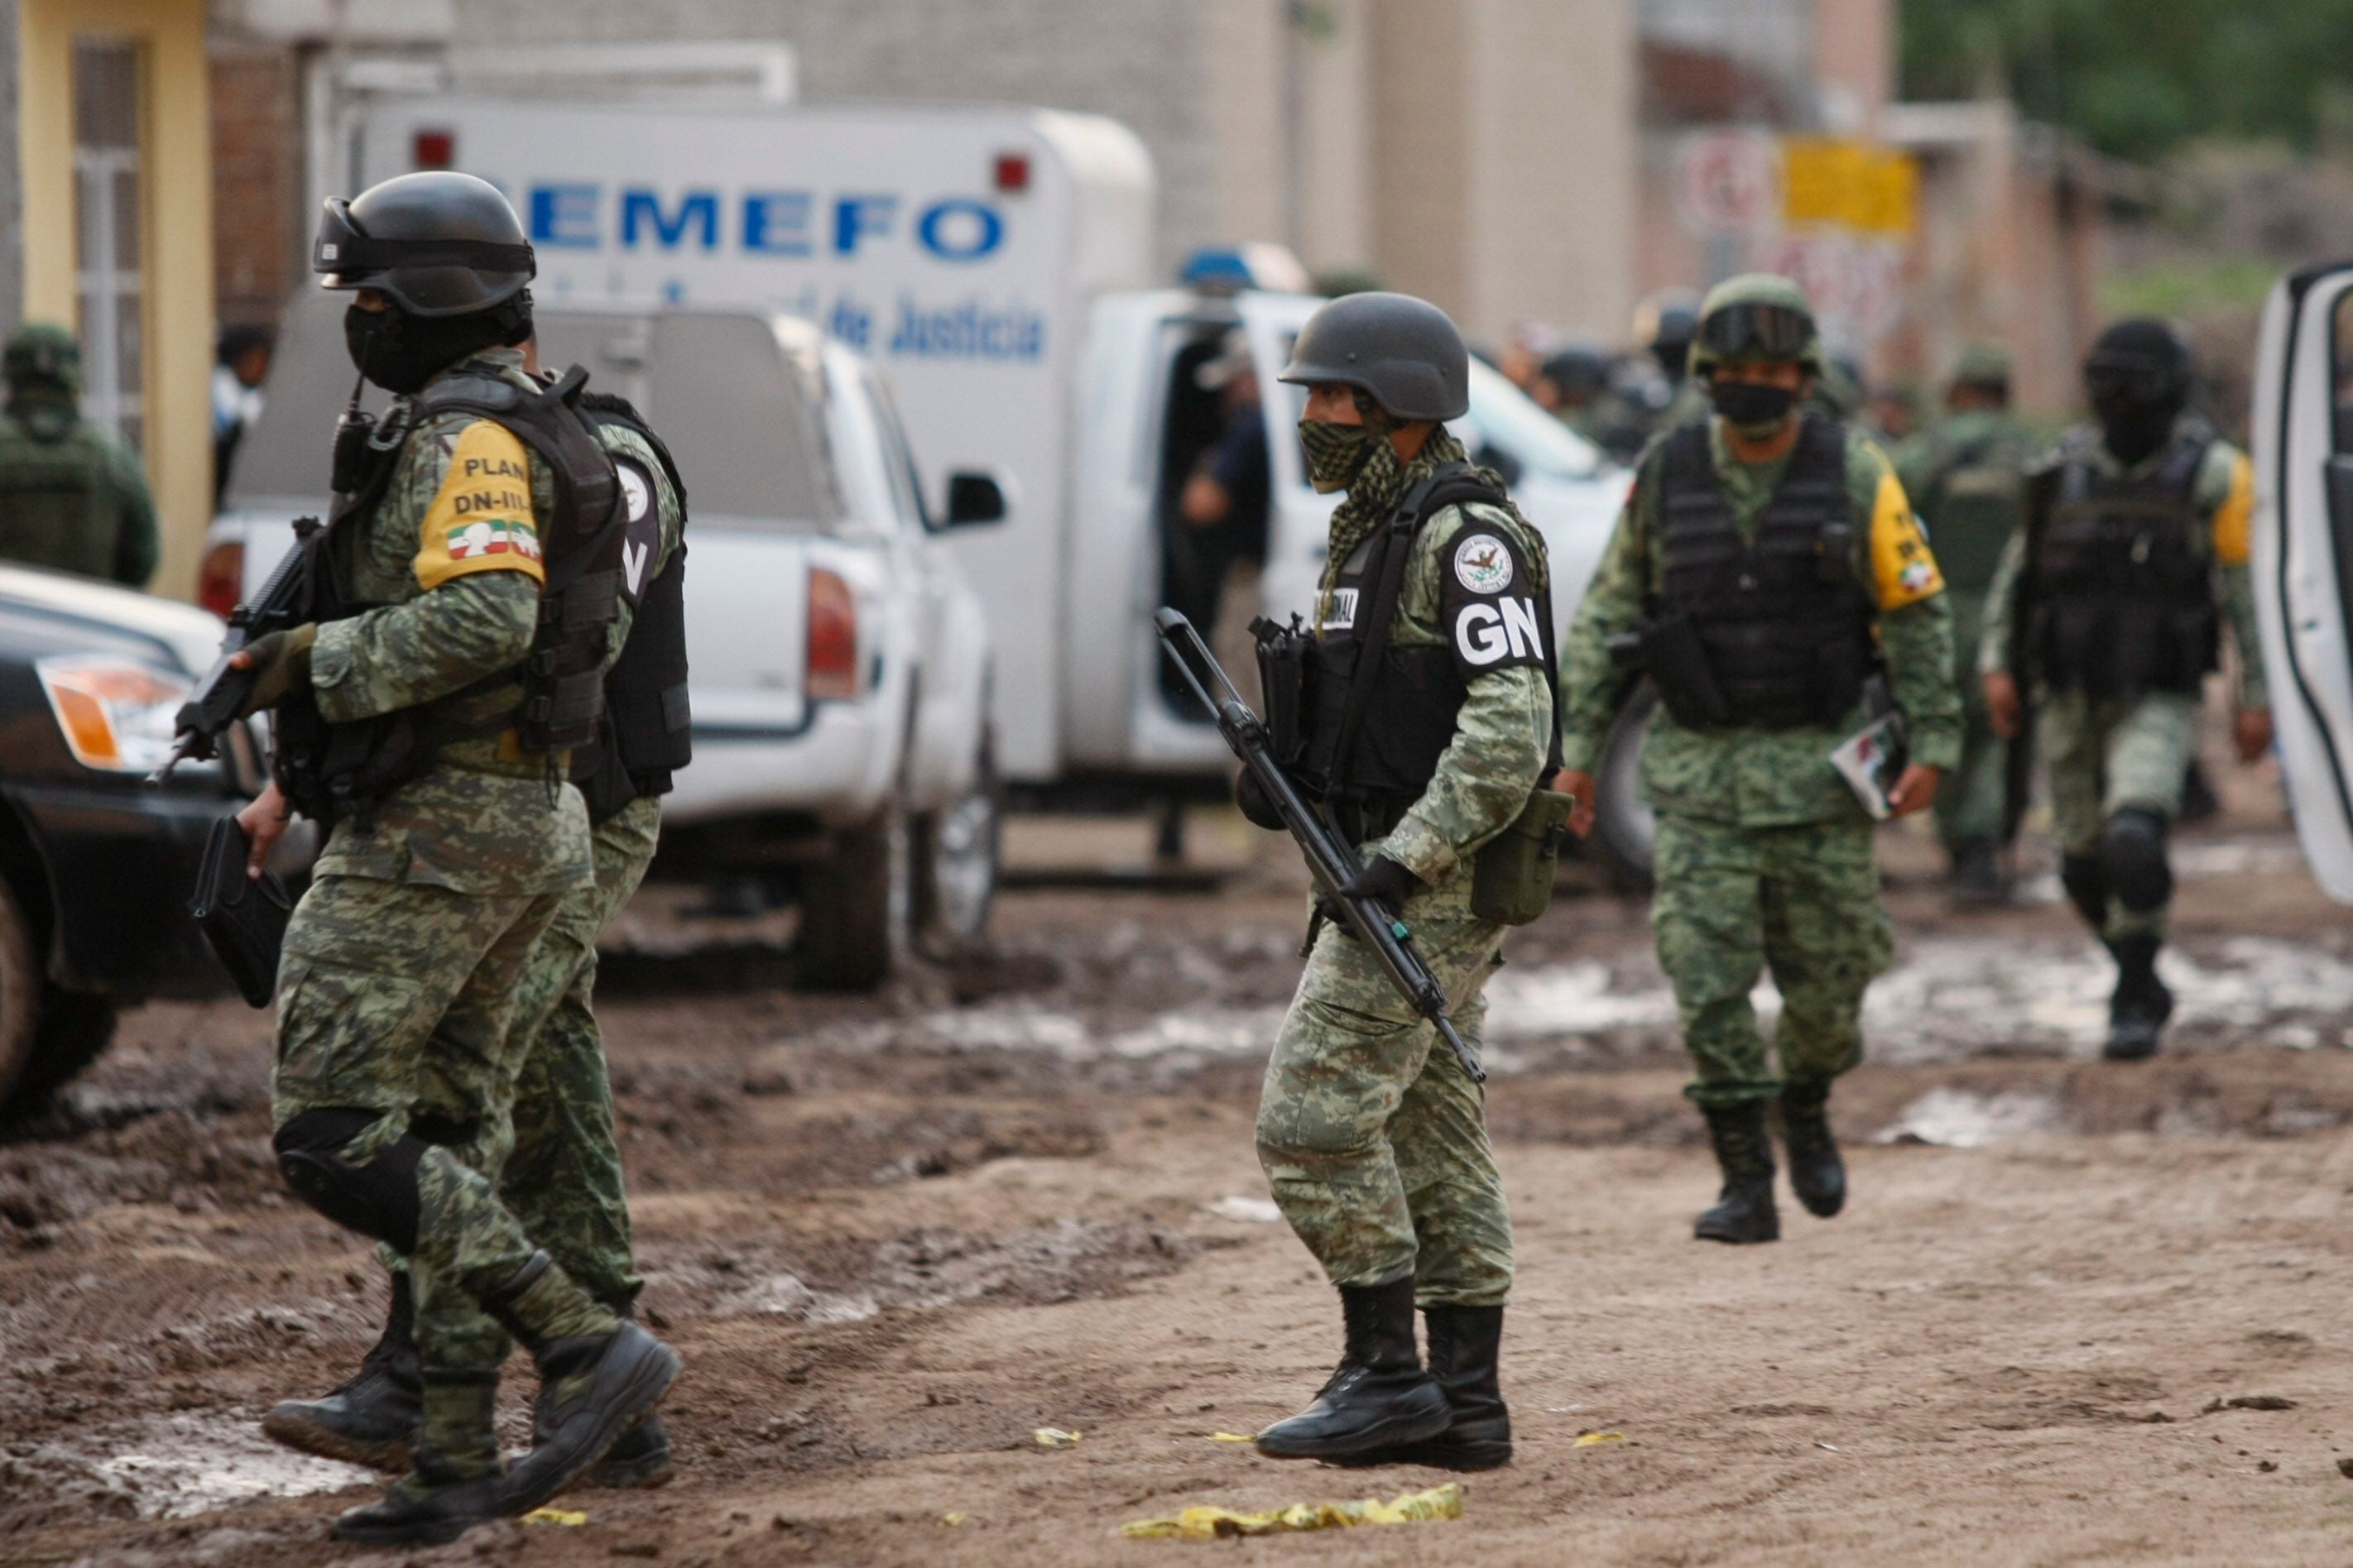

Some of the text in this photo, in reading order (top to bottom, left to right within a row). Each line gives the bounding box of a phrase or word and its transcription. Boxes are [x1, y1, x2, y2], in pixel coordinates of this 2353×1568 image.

[493, 182, 1005, 262] EMEFO
[890, 286, 1042, 362] Justicia
[465, 458, 526, 481] PLAN
[1456, 597, 1544, 665] GN
